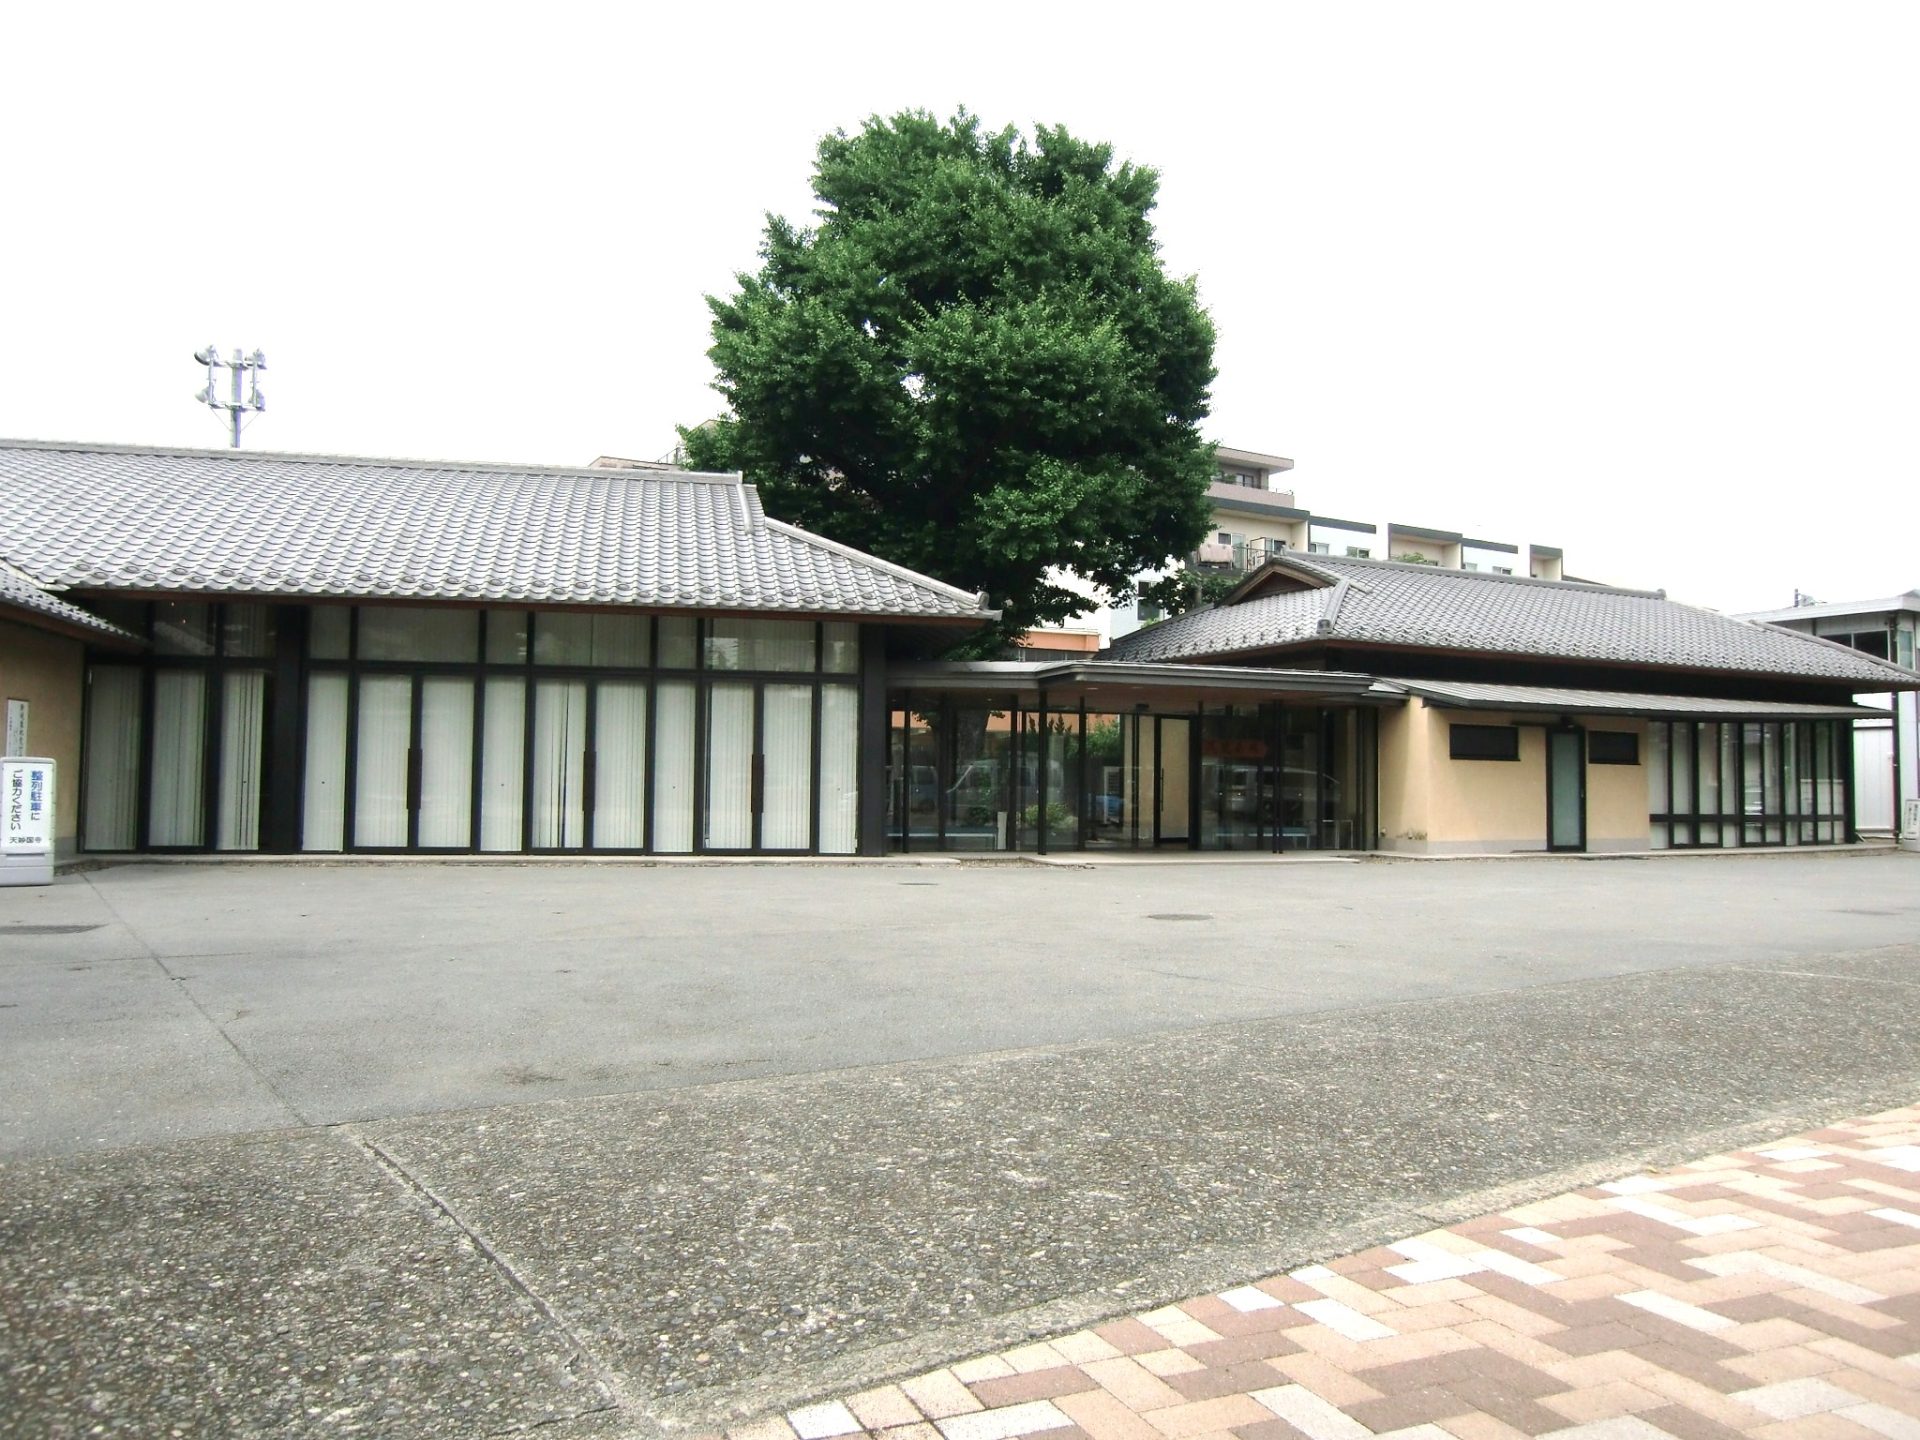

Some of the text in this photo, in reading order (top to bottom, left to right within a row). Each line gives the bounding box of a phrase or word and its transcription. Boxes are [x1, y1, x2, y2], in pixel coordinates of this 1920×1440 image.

[10, 769, 23, 831] ご協力ください
